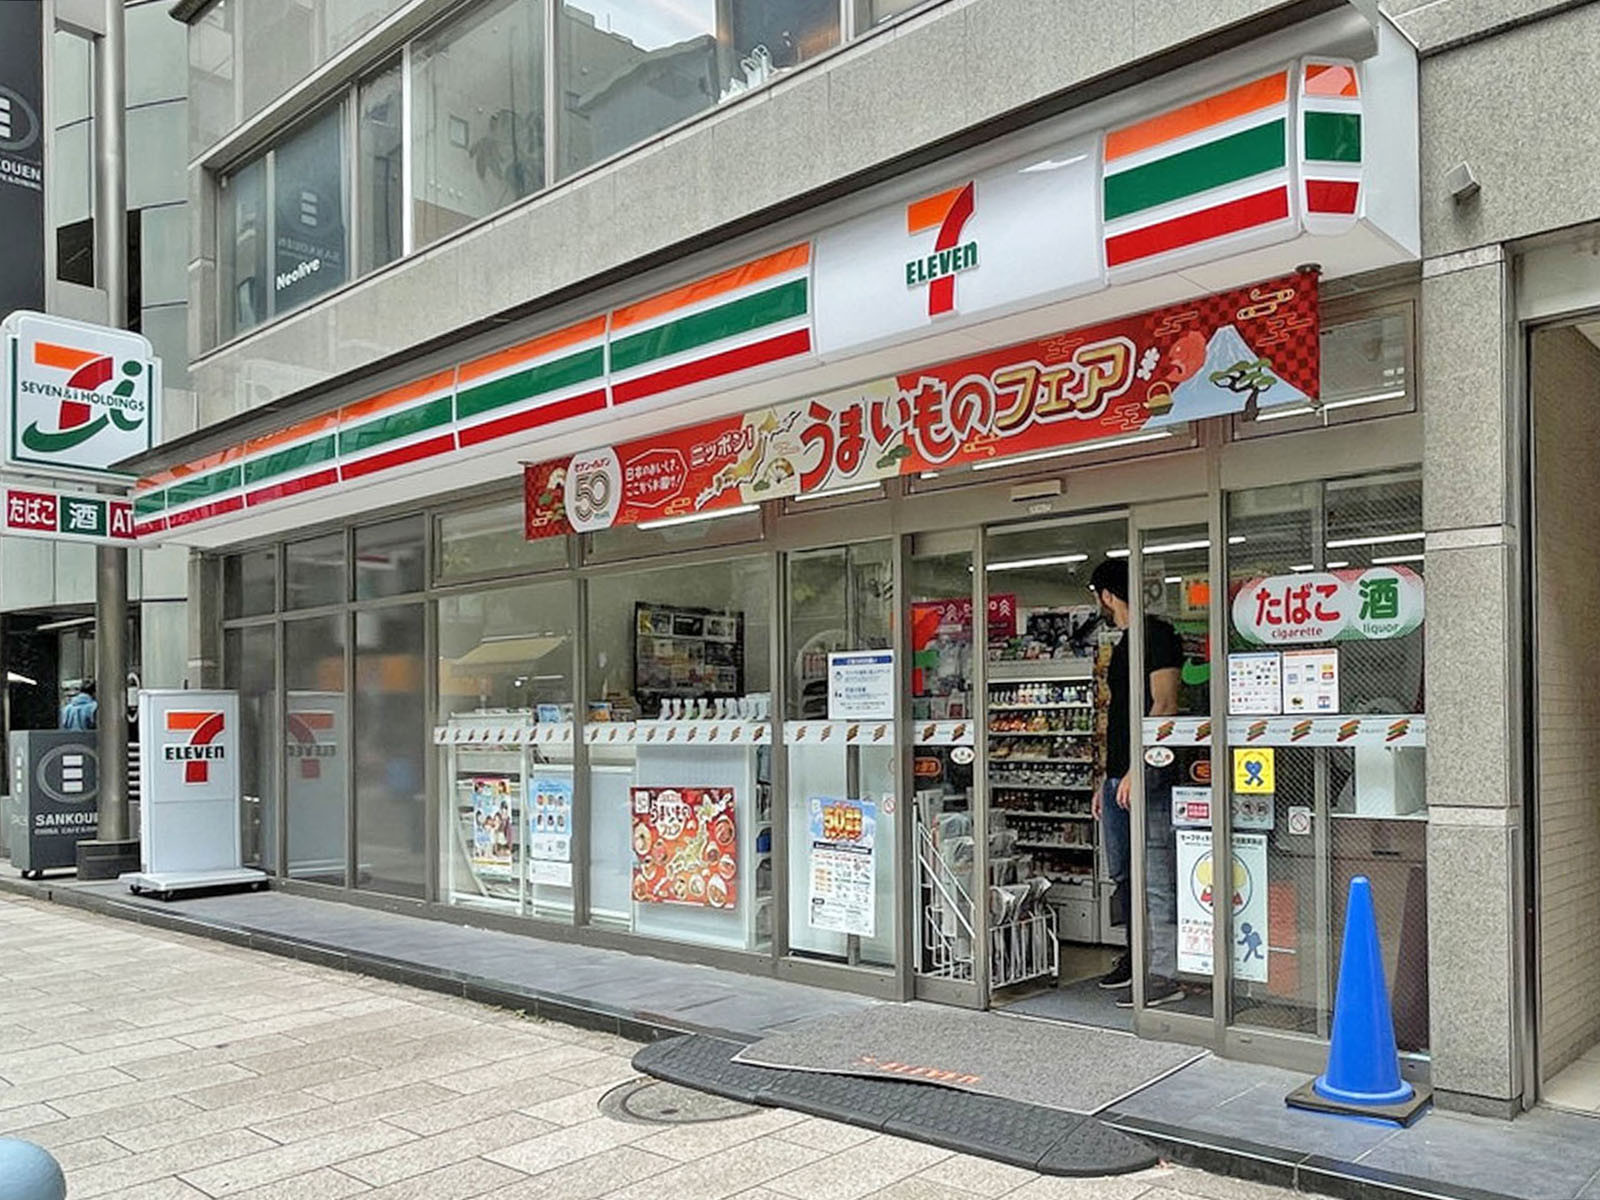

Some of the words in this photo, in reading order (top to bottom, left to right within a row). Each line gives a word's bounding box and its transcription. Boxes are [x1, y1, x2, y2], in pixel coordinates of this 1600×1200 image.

[0, 158, 42, 181] OUEN
[21, 381, 62, 397] SEVEN
[81, 391, 144, 412] HOLDINGS
[799, 340, 1134, 494] うまいものフェア
[691, 425, 753, 467] ニッポン!
[9, 497, 55, 524] たばこ
[69, 502, 98, 530] 酒
[1256, 583, 1340, 626] たばこ
[1359, 578, 1398, 620] 酒
[1272, 627, 1323, 640] cigarette
[1363, 623, 1399, 635] liquor
